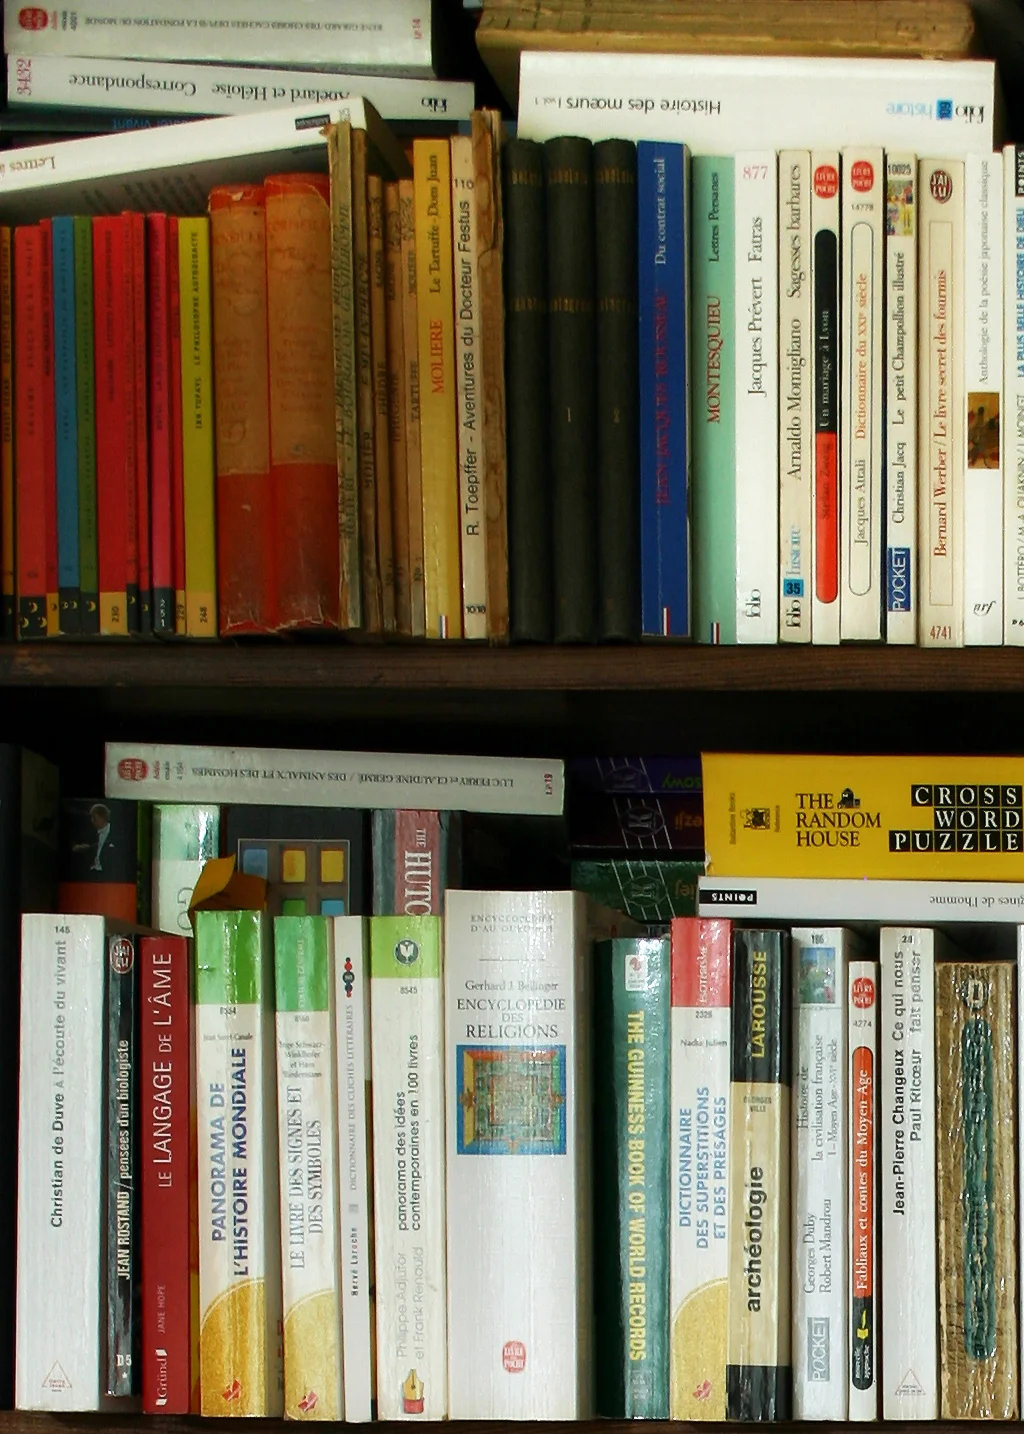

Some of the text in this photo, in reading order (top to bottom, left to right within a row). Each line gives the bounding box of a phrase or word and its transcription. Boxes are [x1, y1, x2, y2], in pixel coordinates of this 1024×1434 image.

[68, 74, 267, 101] Héloïse Correspondance
[566, 97, 721, 115] Histoire des mœurs
[743, 166, 769, 180] 877
[706, 173, 721, 424] MONTESQUIEU Lettres Persanes
[430, 320, 444, 393] MOLIERE
[457, 201, 479, 536] R. Toepffer Aventures du Docteur Festus
[892, 548, 907, 610] POCKET
[796, 793, 834, 809] THE
[915, 788, 1018, 805] CROSS
[796, 812, 880, 828] RANDOM
[796, 831, 860, 847] HOUSE
[935, 810, 1020, 828] WORD
[895, 834, 1019, 851] PUZZLE
[53, 940, 67, 986] vivant
[52, 991, 67, 1009] du
[751, 952, 768, 1058] LAROUSSE
[51, 1015, 67, 1074] l'écoute
[466, 1024, 559, 1038] RELIGIONS
[147, 953, 172, 1187] LE LANGAGE DE L'ÂME
[51, 1093, 65, 1132] Duve
[50, 1137, 65, 1155] de
[209, 1083, 227, 1241] PANORAMA DE
[231, 1048, 249, 1276] L'HISTOIRE MONDIALE
[50, 1161, 65, 1228] Christian
[745, 1167, 766, 1312] archéologie
[155, 1357, 169, 1398] Gründ
